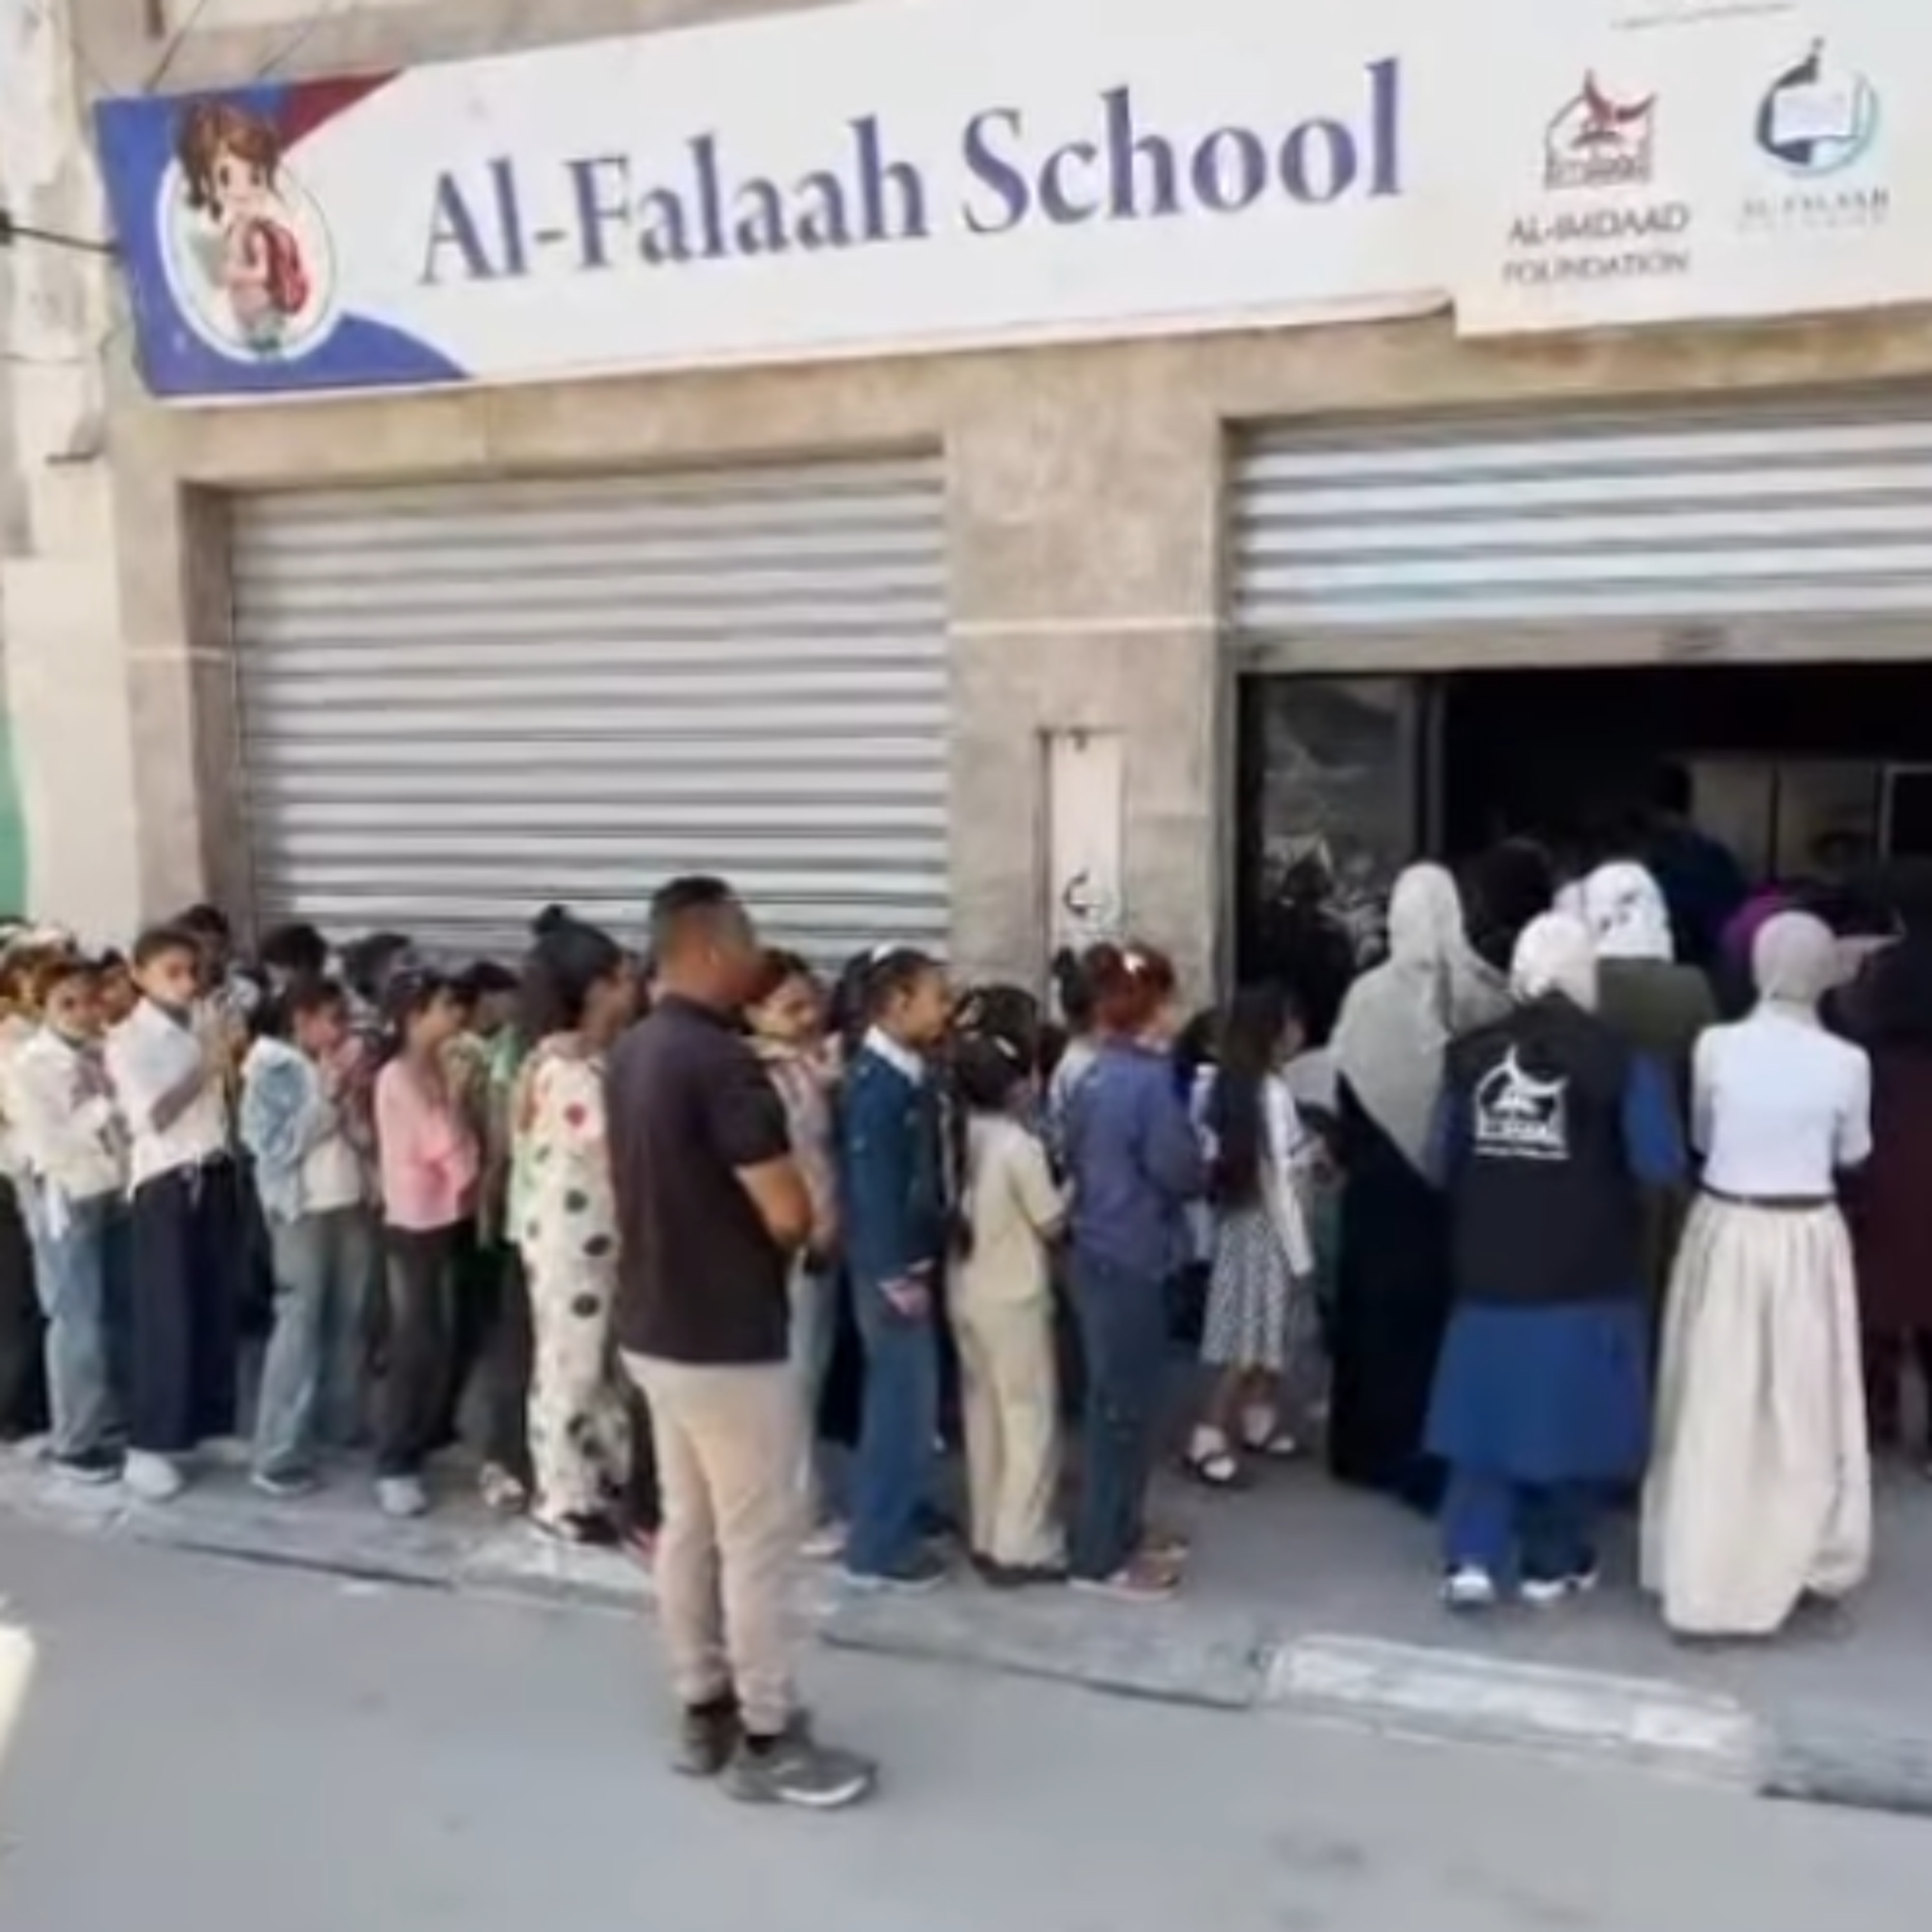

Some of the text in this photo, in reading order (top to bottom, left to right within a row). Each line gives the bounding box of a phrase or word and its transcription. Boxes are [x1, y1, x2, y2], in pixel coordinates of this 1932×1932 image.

[419, 56, 1402, 285] Al-Falaah School
[1508, 201, 1690, 246] AL-IMDAAD
[1502, 249, 1689, 282] FOUNDATION
